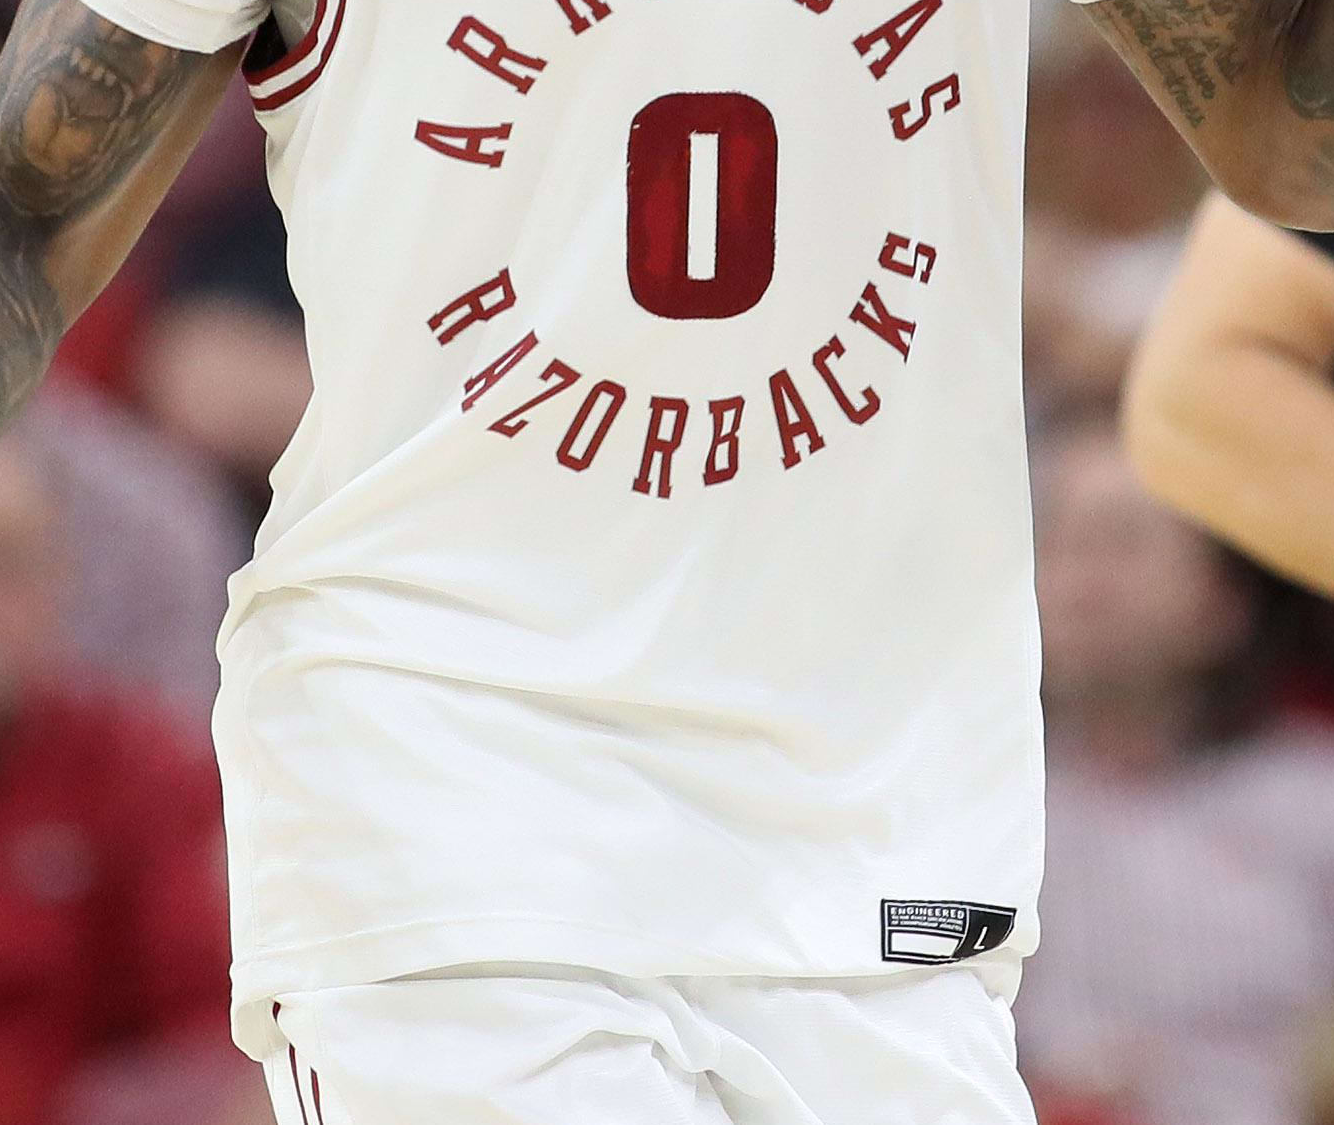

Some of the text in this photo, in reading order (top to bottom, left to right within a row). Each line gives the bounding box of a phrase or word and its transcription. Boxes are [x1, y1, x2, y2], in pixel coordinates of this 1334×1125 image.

[628, 93, 777, 319] 0
[426, 233, 938, 499] RAZORBACKS
[890, 906, 965, 919] ENGINEERED
[973, 926, 987, 950] L
